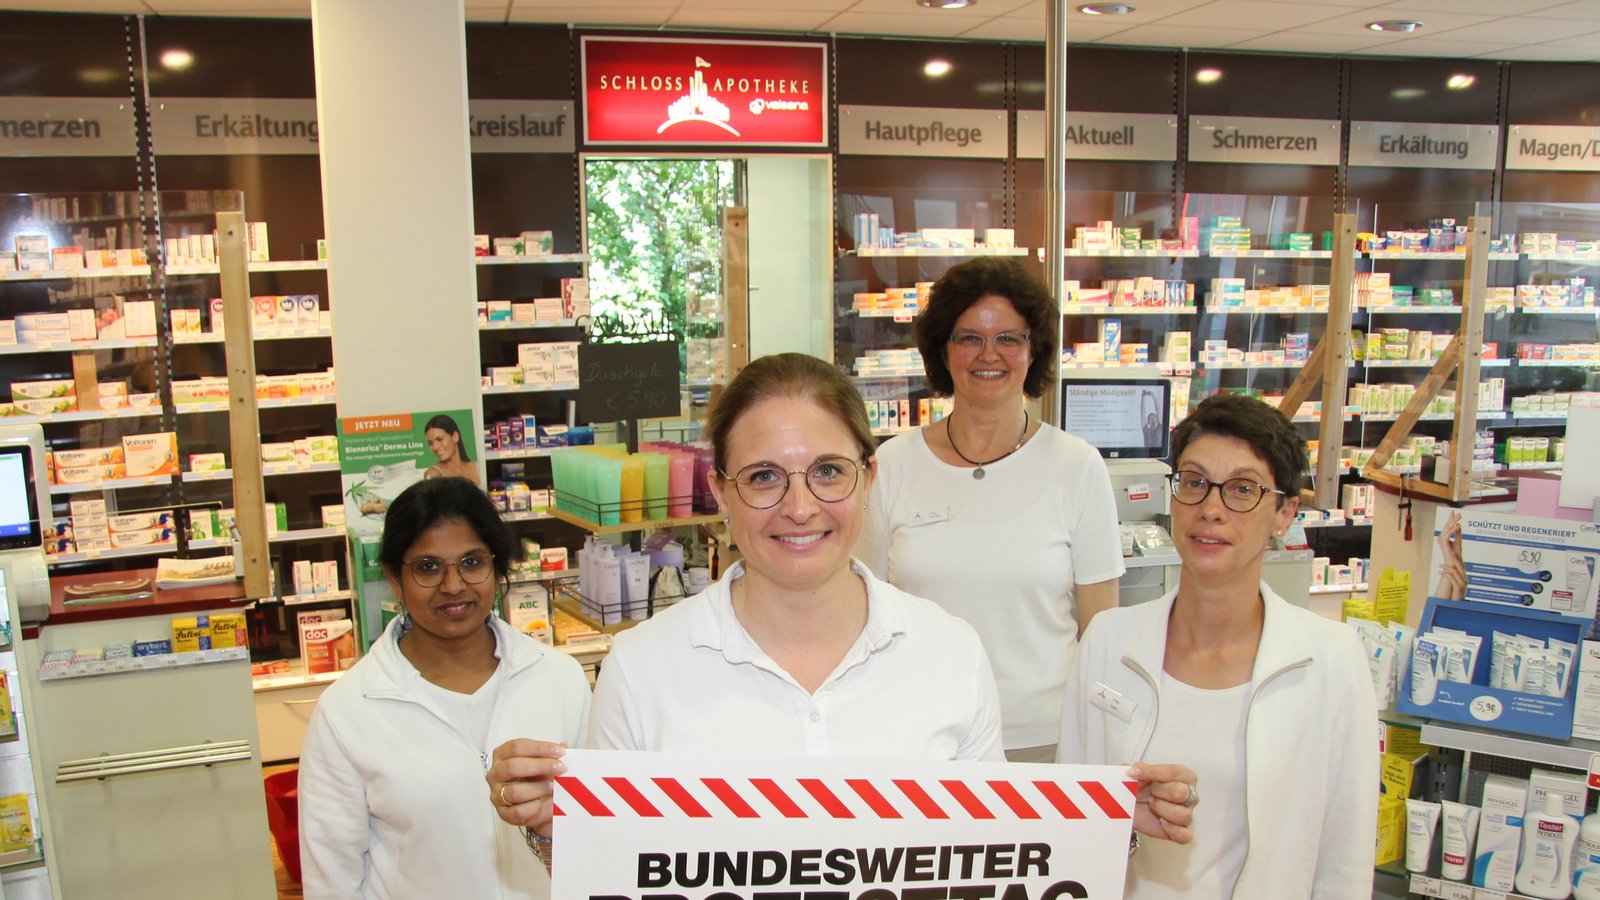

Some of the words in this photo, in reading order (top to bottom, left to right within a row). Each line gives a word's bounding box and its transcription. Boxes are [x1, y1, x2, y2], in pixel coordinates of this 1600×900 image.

[600, 74, 683, 92] SCHLOSS
[713, 78, 810, 94] APOTHEKE
[0, 117, 101, 138] merzen
[196, 114, 318, 142] Erkältung
[865, 119, 982, 147] Hautpflege
[1065, 125, 1134, 146] Aktuell
[1212, 129, 1318, 151] Schmerzen
[1379, 133, 1469, 159] Erkältung
[1069, 388, 1099, 397] Ständige
[1100, 389, 1137, 398] Müdigkeit?
[355, 420, 379, 431] JETZT
[382, 419, 400, 428] NEU
[125, 438, 157, 447] Voltaren
[383, 443, 407, 451] Derma
[1468, 520, 1502, 530] SCHÜTZT
[1503, 524, 1520, 532] UND
[1521, 526, 1577, 538] REGENERIERT
[519, 601, 539, 610] ABC
[306, 629, 328, 640] doc
[137, 642, 167, 651] wybert
[1539, 821, 1563, 832] Tester
[637, 842, 1051, 888] BUNDESWEITER
[1445, 855, 1463, 864] TESTER
